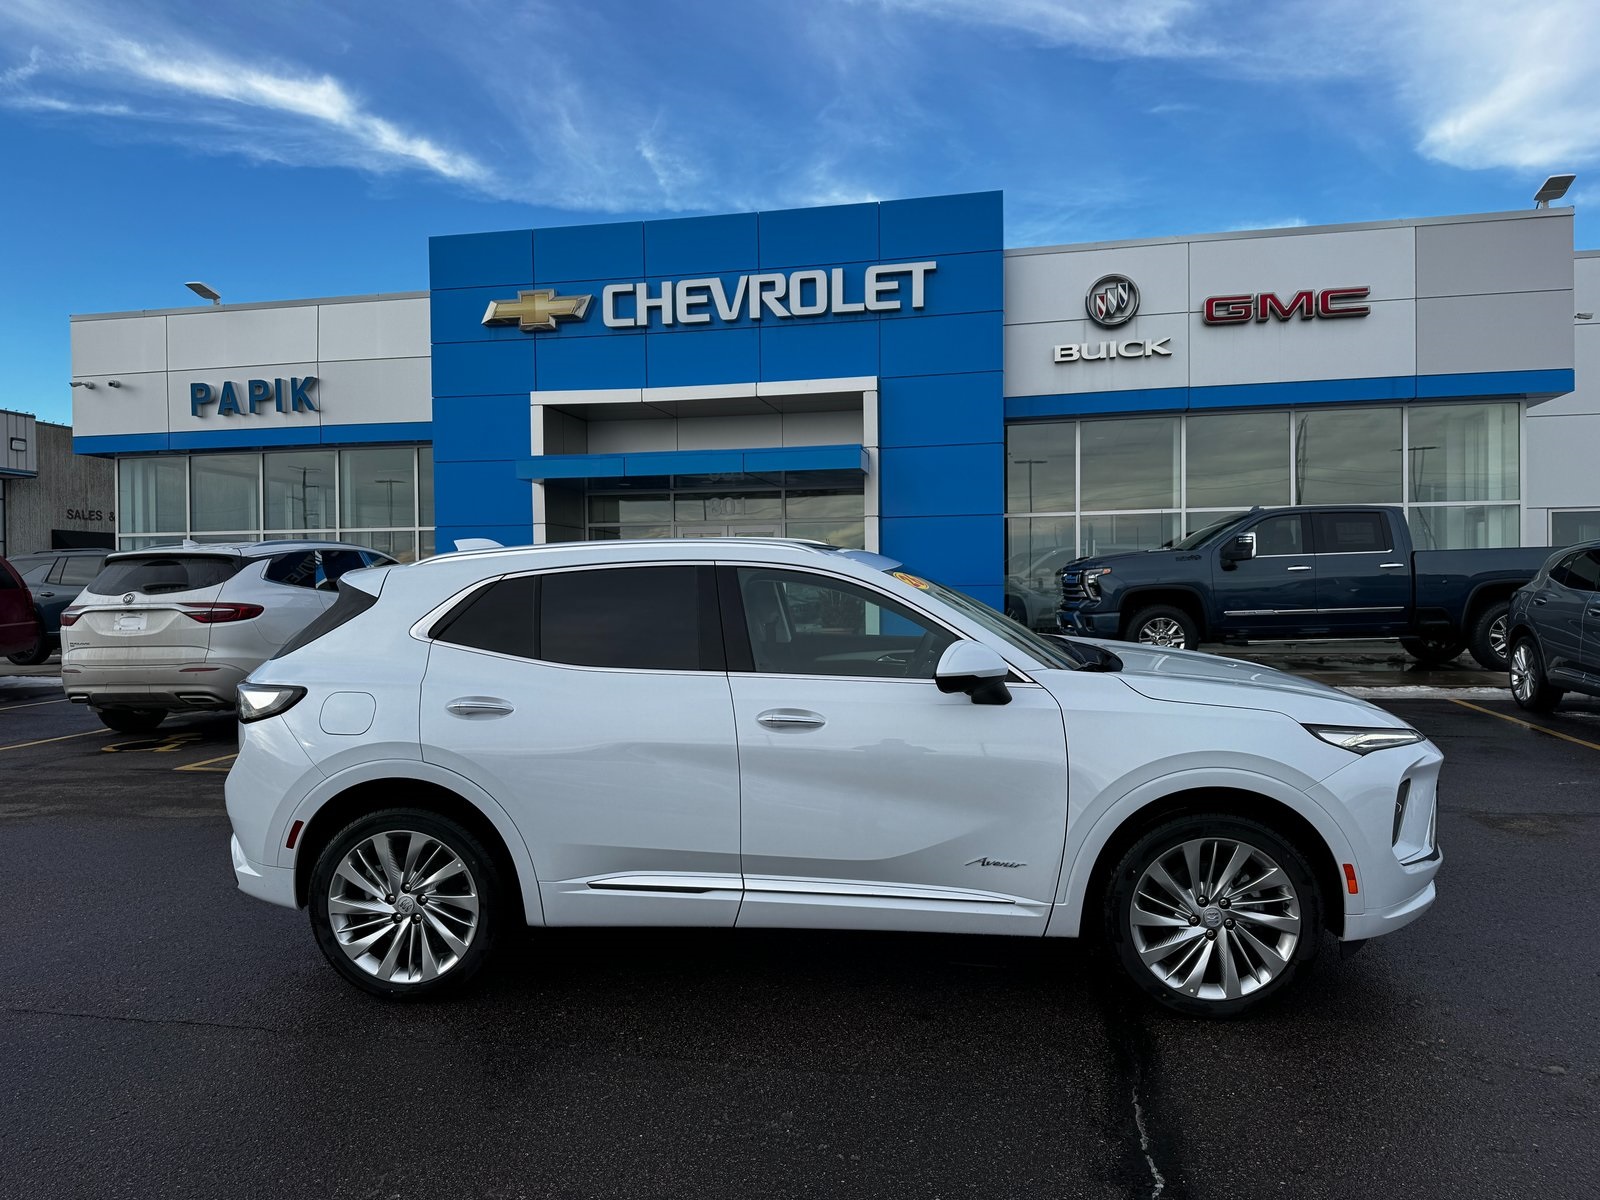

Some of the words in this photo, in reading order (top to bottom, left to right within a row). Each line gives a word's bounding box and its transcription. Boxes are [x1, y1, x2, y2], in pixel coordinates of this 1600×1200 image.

[602, 260, 937, 328] CHEVROLET
[1202, 285, 1371, 325] GMC
[1053, 336, 1173, 364] BUICK
[189, 376, 320, 417] PAPIK
[66, 509, 103, 521] SALES
[108, 511, 115, 521] &
